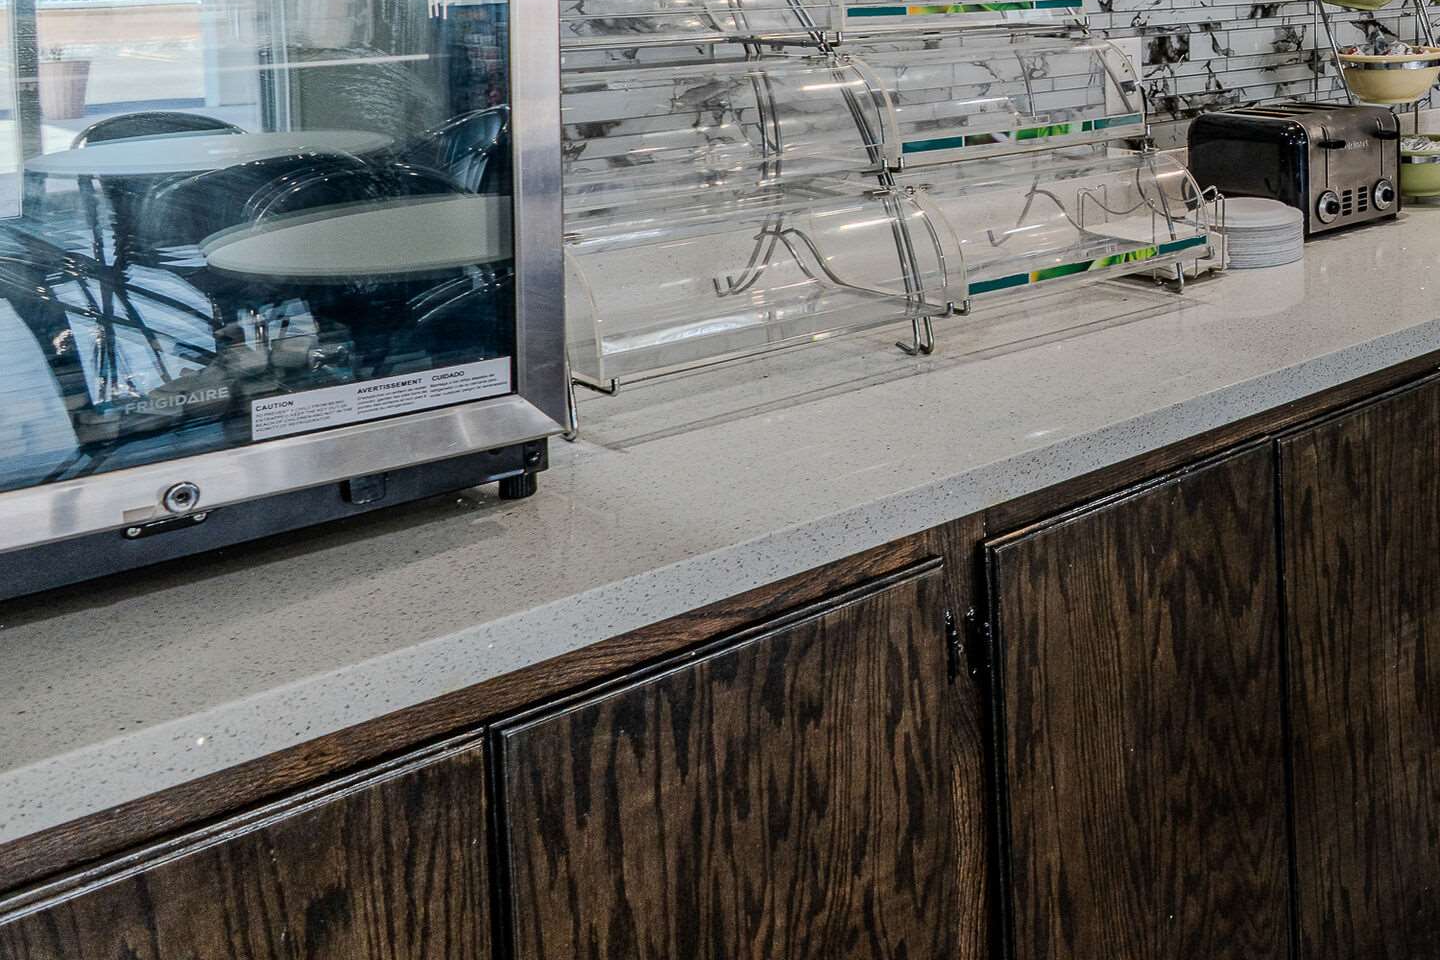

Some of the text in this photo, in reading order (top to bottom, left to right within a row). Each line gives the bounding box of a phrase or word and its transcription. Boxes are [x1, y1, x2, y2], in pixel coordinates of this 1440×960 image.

[357, 377, 423, 395] AVERTISSEMENT
[431, 370, 465, 382] CUIDADO
[125, 386, 231, 415] FRIGIDAIRE
[255, 400, 295, 412] CAUTION
